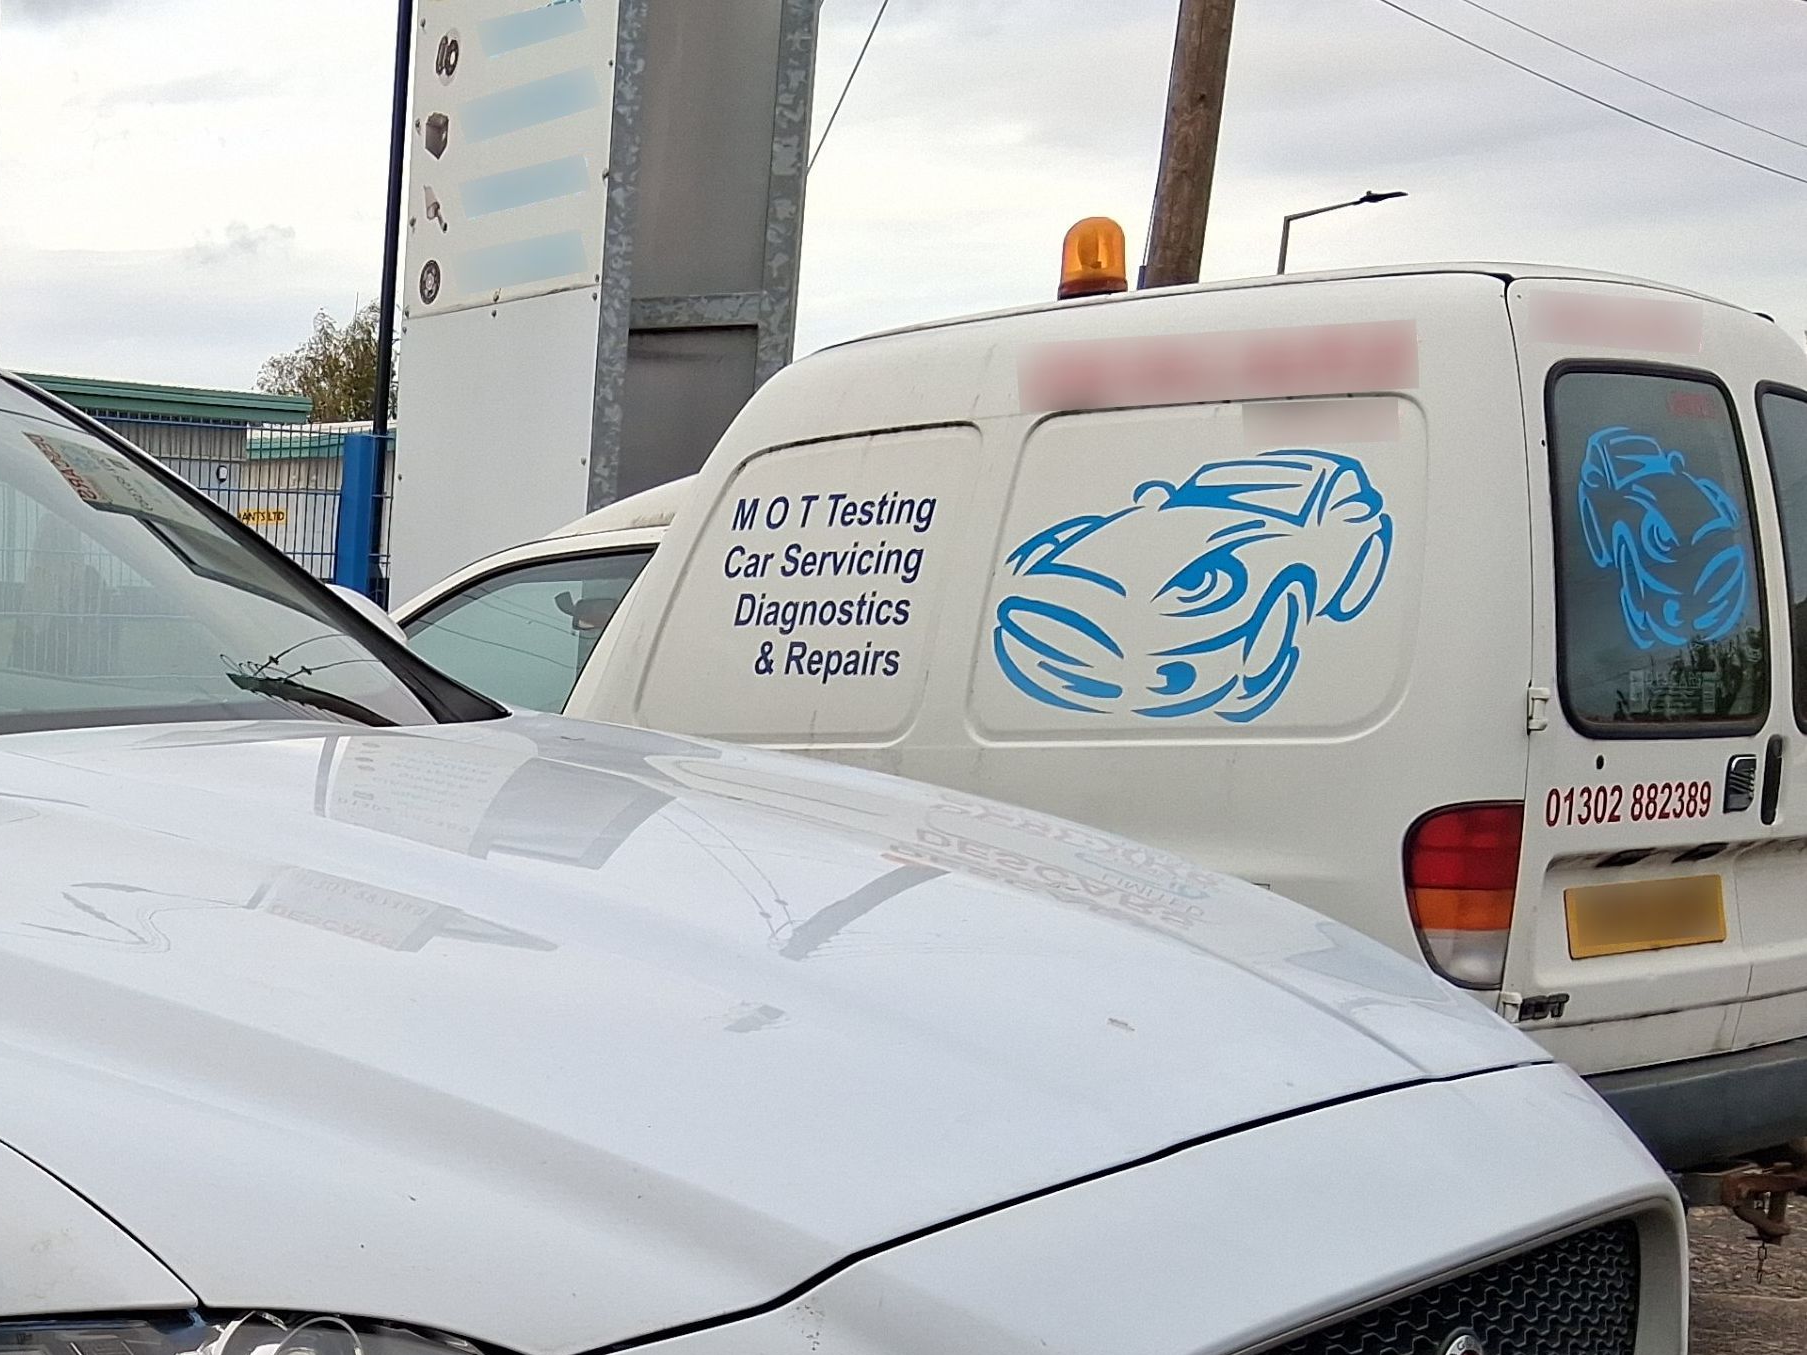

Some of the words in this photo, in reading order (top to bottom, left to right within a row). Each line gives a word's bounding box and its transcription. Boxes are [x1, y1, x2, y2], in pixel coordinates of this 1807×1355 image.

[732, 498, 760, 530] M
[766, 496, 790, 530] O
[800, 494, 820, 528] T
[828, 491, 937, 533] Testing
[724, 545, 775, 579] Car
[780, 541, 924, 584] Servicing
[734, 591, 911, 635] Diagnostics
[754, 641, 774, 675] &
[784, 641, 901, 684] Repairs
[1545, 784, 1623, 827] 01302
[1630, 780, 1712, 822] 882389
